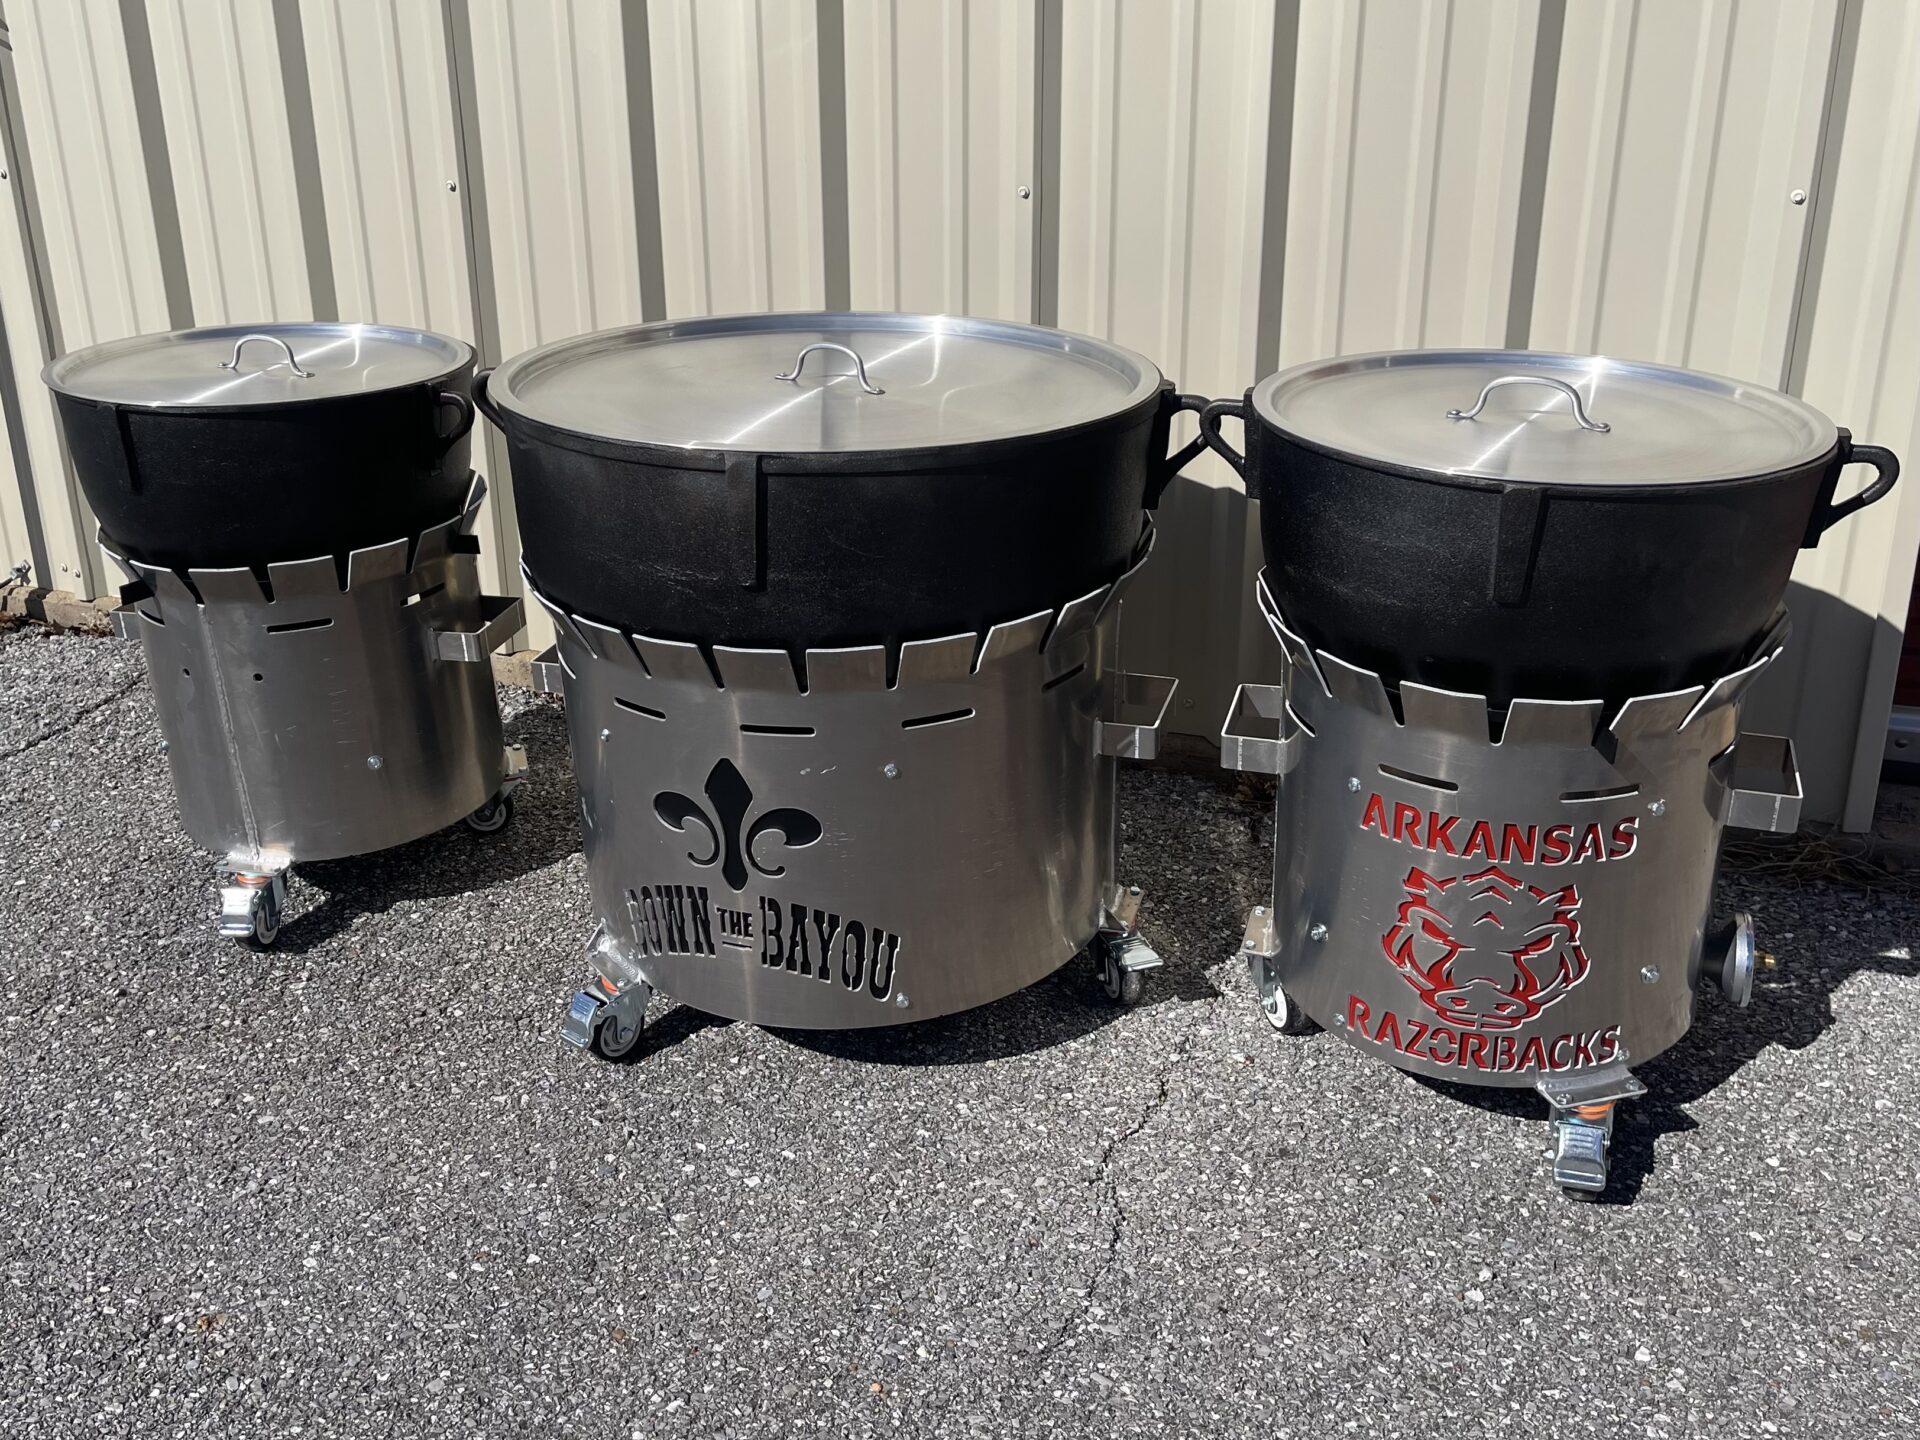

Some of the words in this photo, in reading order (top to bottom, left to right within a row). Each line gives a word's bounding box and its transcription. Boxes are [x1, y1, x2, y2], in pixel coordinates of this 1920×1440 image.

[1360, 793, 1639, 865] ARKANSAS
[715, 905, 754, 938] THE
[758, 895, 901, 1002] BAYOU
[1346, 994, 1621, 1073] RAZORBACKS
